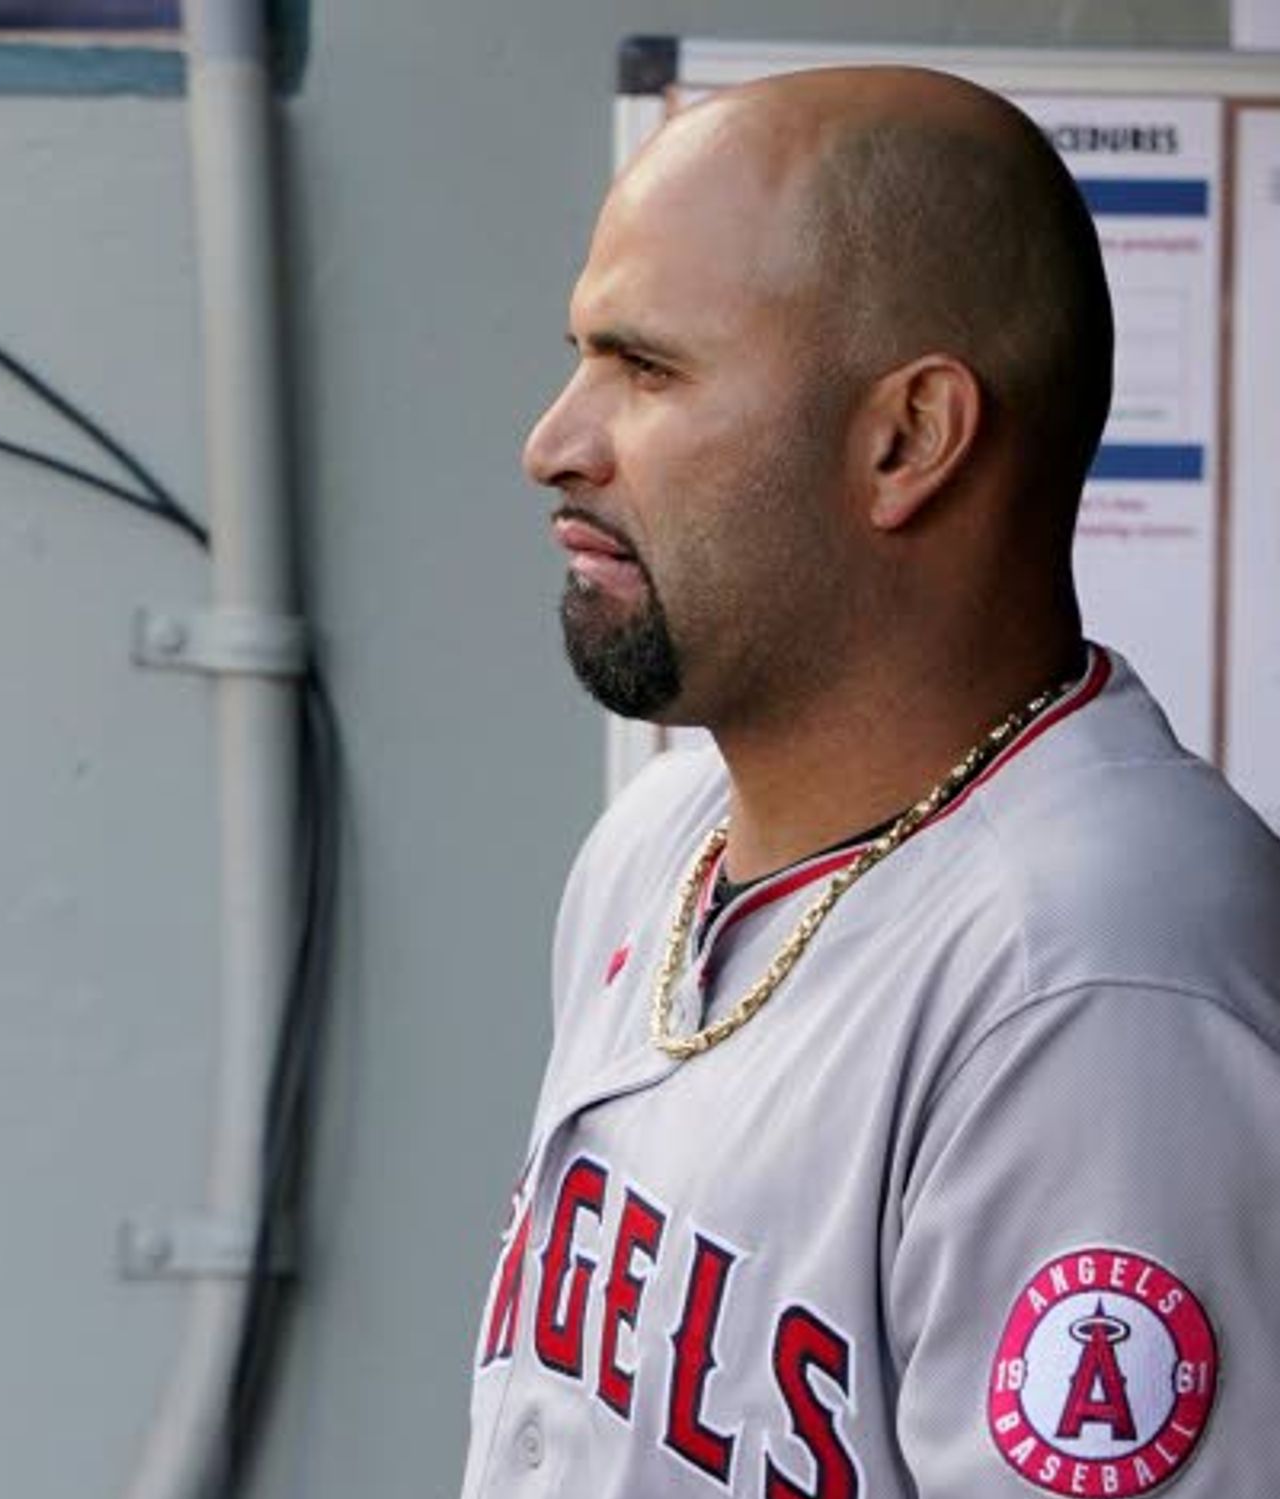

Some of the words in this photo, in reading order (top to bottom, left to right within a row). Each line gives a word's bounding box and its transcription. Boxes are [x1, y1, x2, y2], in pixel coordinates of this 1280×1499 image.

[1025, 1255, 1184, 1316] ANGELS
[995, 1358, 1026, 1392] 19
[1176, 1360, 1209, 1394] 61
[994, 1411, 1197, 1493] BASEBALL
